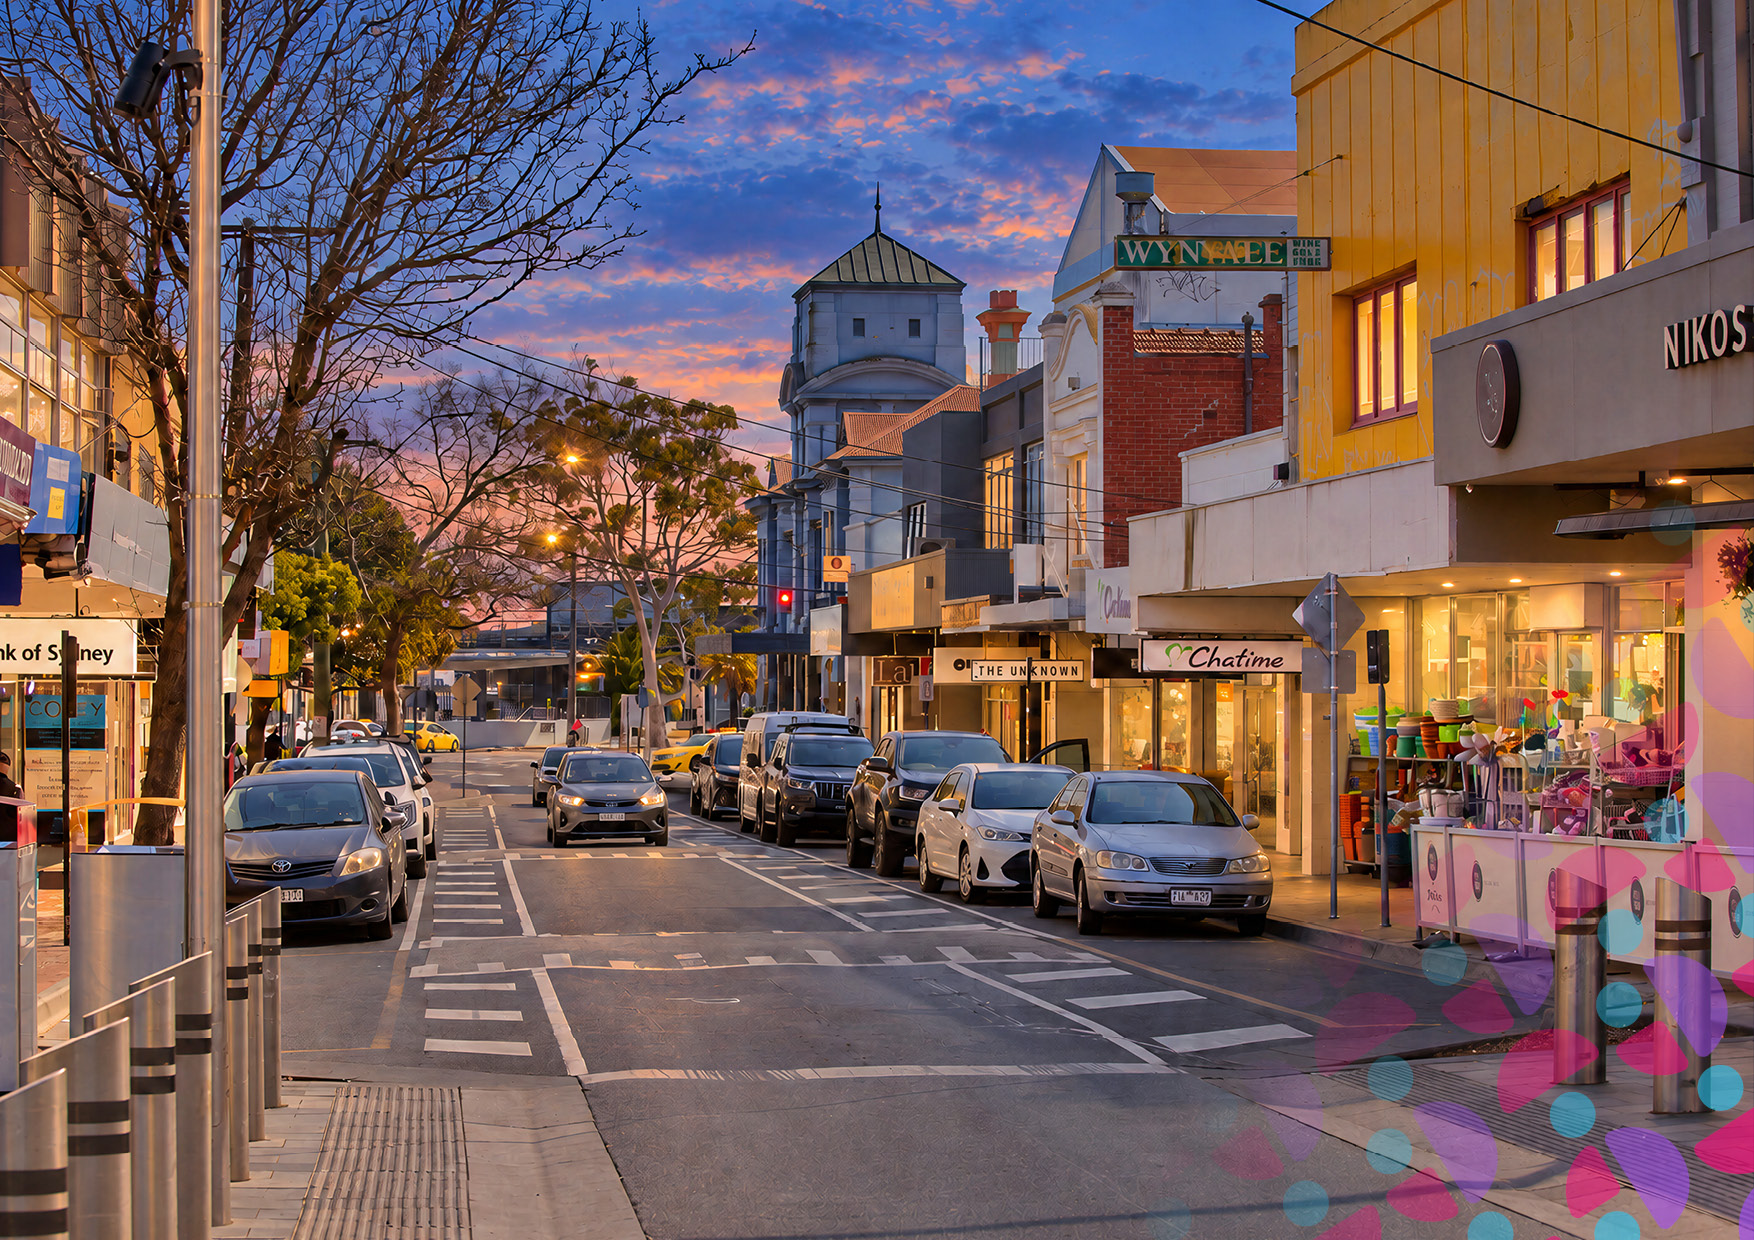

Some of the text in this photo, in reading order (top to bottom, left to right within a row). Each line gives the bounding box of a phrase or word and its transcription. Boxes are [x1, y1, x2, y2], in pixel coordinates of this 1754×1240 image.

[1663, 303, 1747, 370] NIKOS
[22, 643, 42, 661] of
[47, 644, 114, 666] Sney
[1188, 645, 1284, 668] Chatime
[979, 665, 1003, 676] THE
[1010, 665, 1078, 676] UNKNOWN
